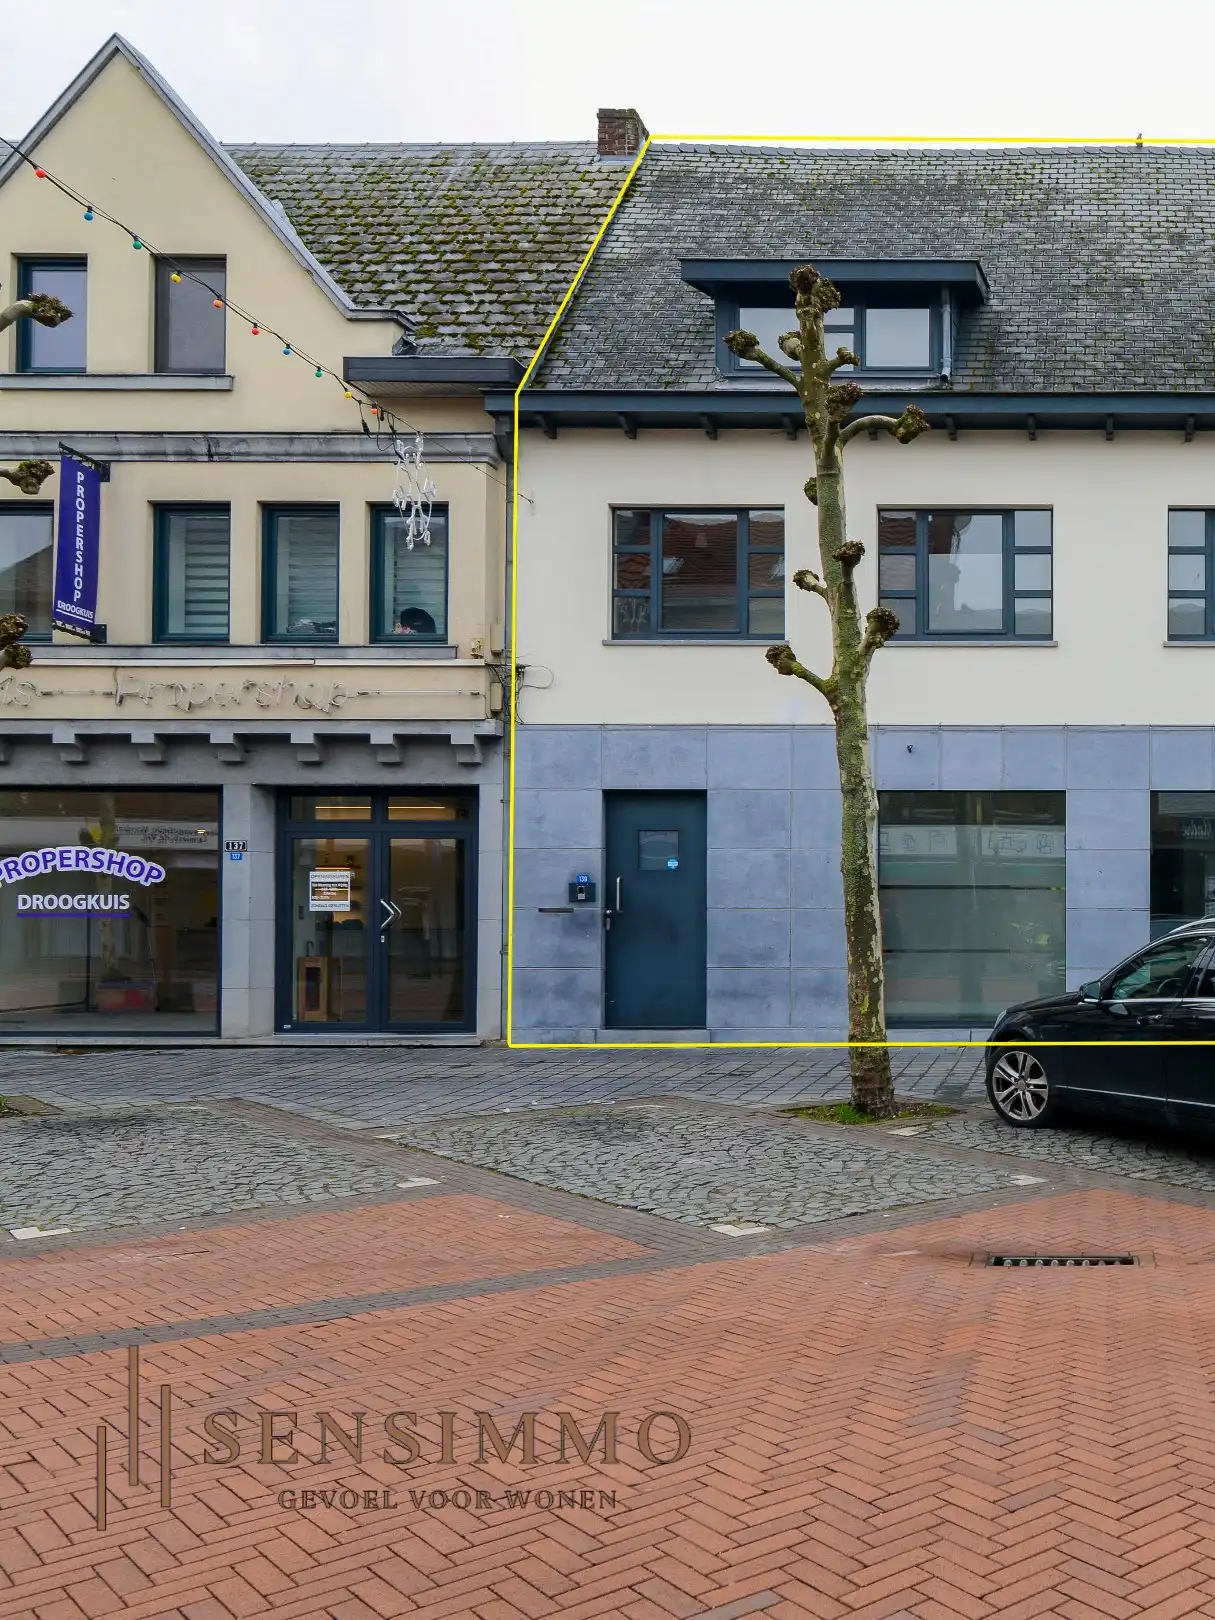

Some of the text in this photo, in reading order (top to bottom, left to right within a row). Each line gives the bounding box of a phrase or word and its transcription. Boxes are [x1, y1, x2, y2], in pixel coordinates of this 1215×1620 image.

[73, 471, 85, 602] PROPERSHOP
[57, 600, 94, 619] DROOGKUIS
[229, 842, 243, 850] 137
[17, 894, 130, 910] DROOGKUIS
